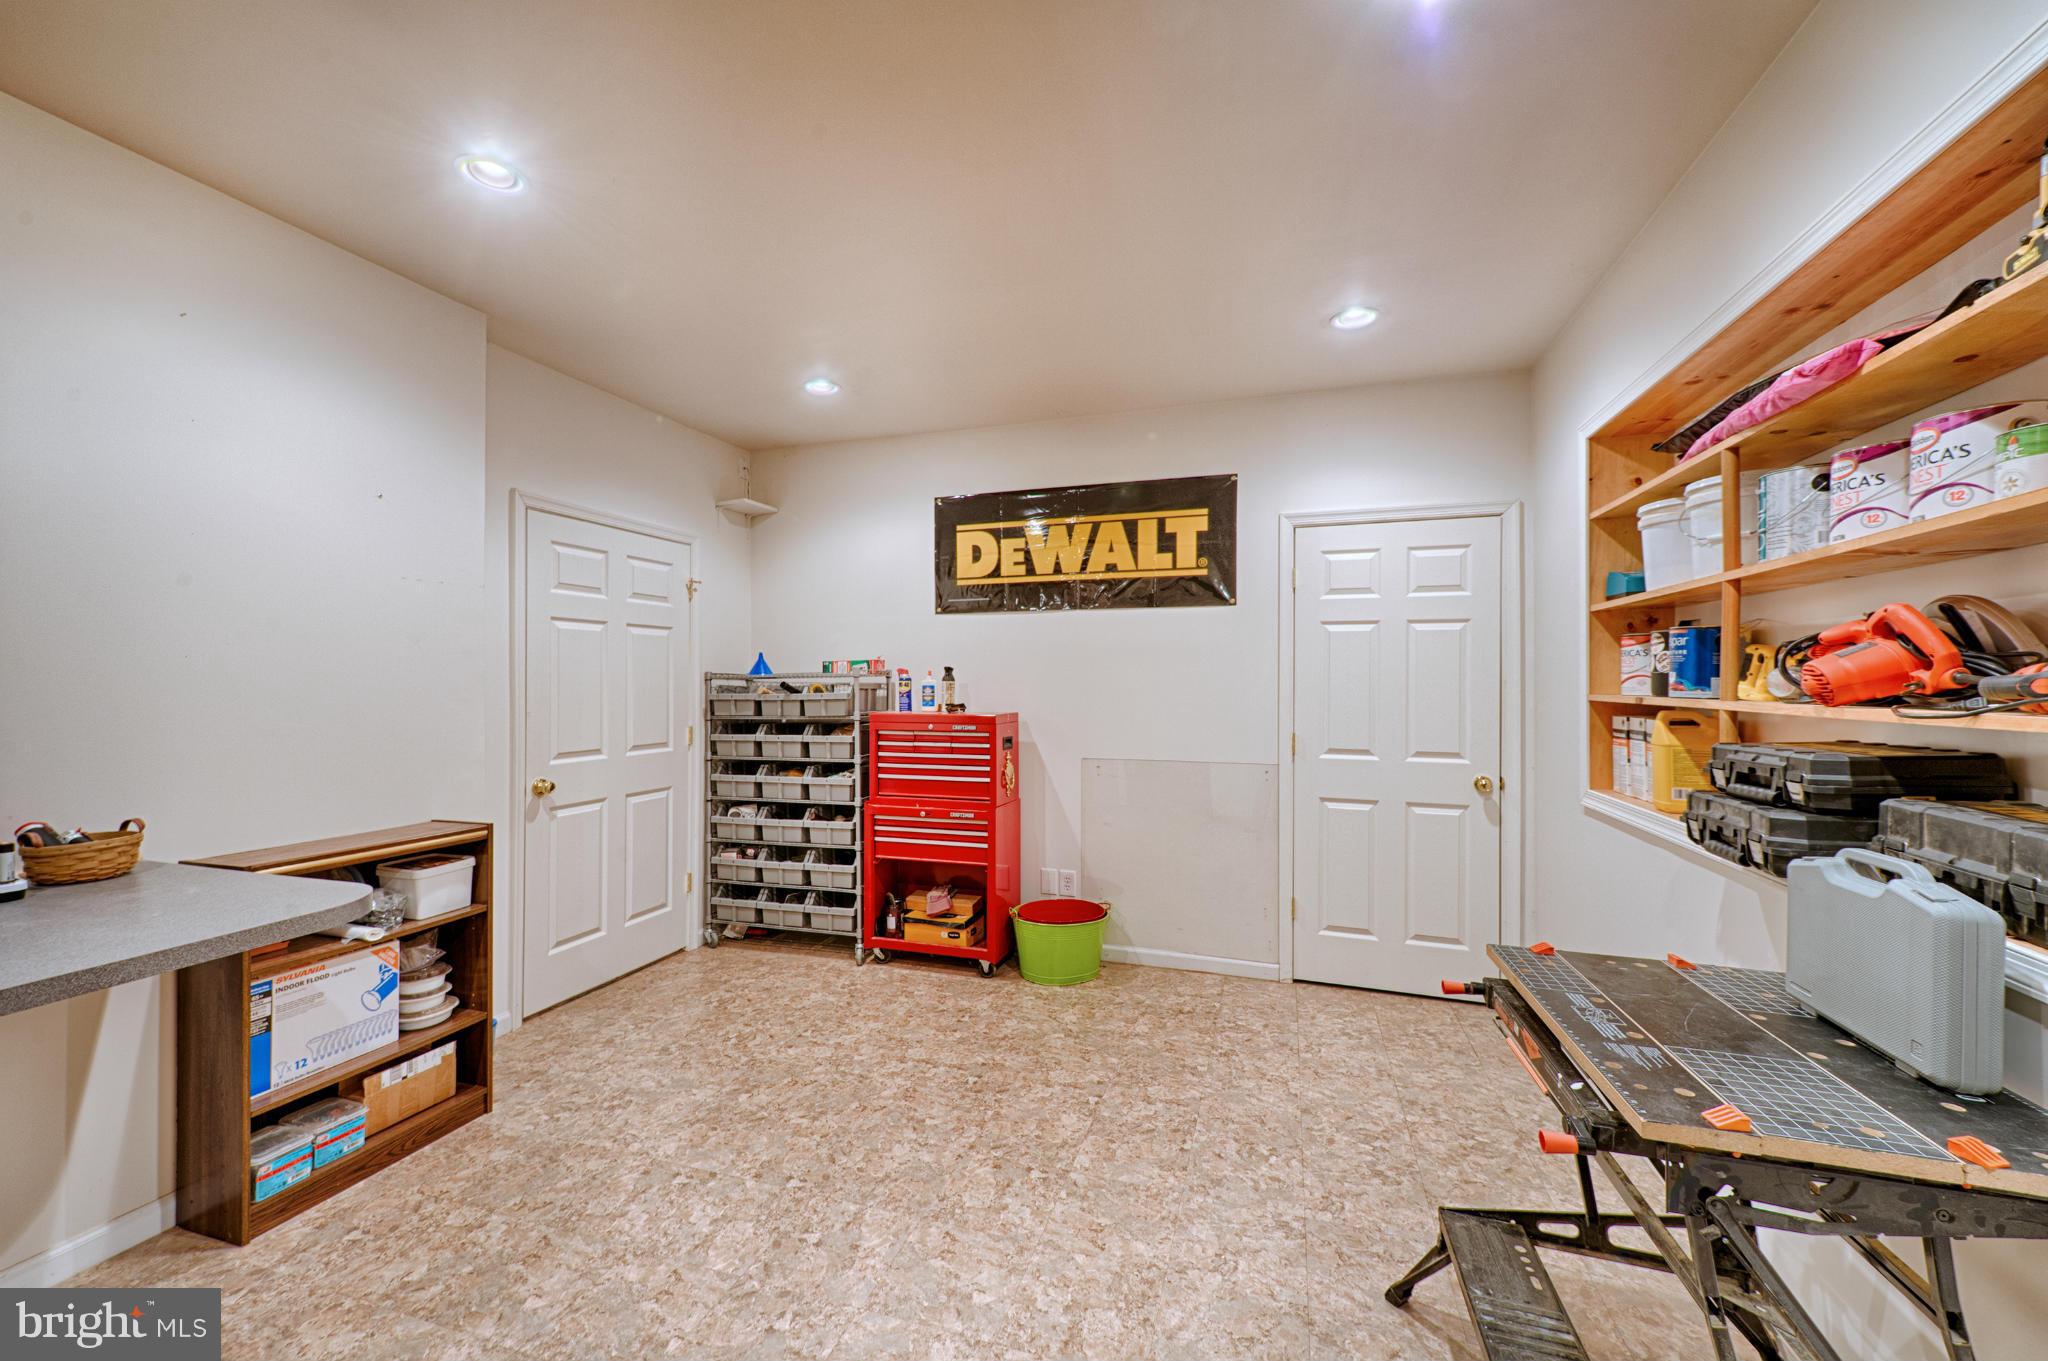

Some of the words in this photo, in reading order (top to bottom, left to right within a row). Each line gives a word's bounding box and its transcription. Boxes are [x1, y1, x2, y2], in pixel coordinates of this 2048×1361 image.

[1949, 490, 1966, 501] 12
[1866, 513, 1881, 523] 12
[275, 964, 327, 985] SYLVANIA
[275, 980, 305, 994] INDOOR
[306, 972, 330, 985] FLOOD
[295, 1058, 308, 1071] 12
